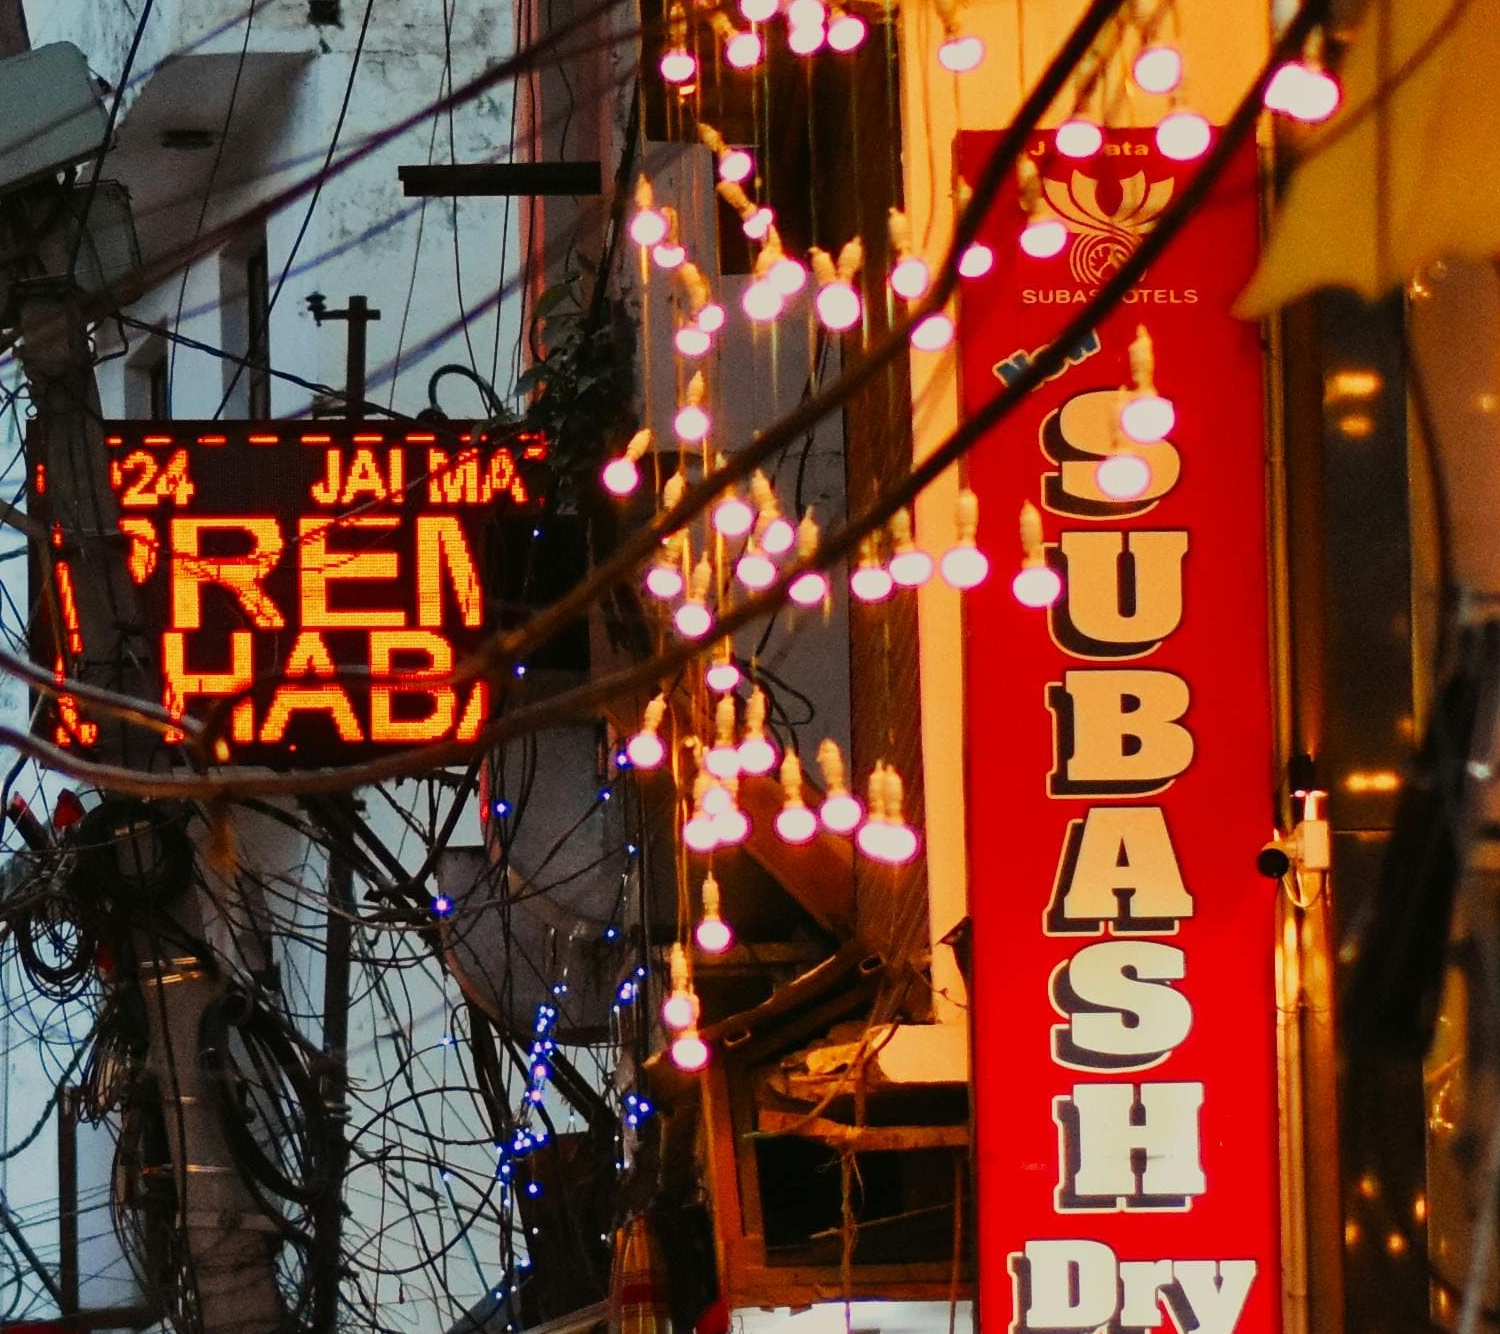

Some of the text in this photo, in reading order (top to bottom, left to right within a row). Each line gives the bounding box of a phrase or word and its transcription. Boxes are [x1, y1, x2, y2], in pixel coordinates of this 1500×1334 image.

[311, 449, 404, 505] JAI
[429, 448, 545, 506] MA
[60, 516, 483, 628] RE
[58, 631, 489, 745] HAB
[1038, 389, 1208, 1214] SUBASH
